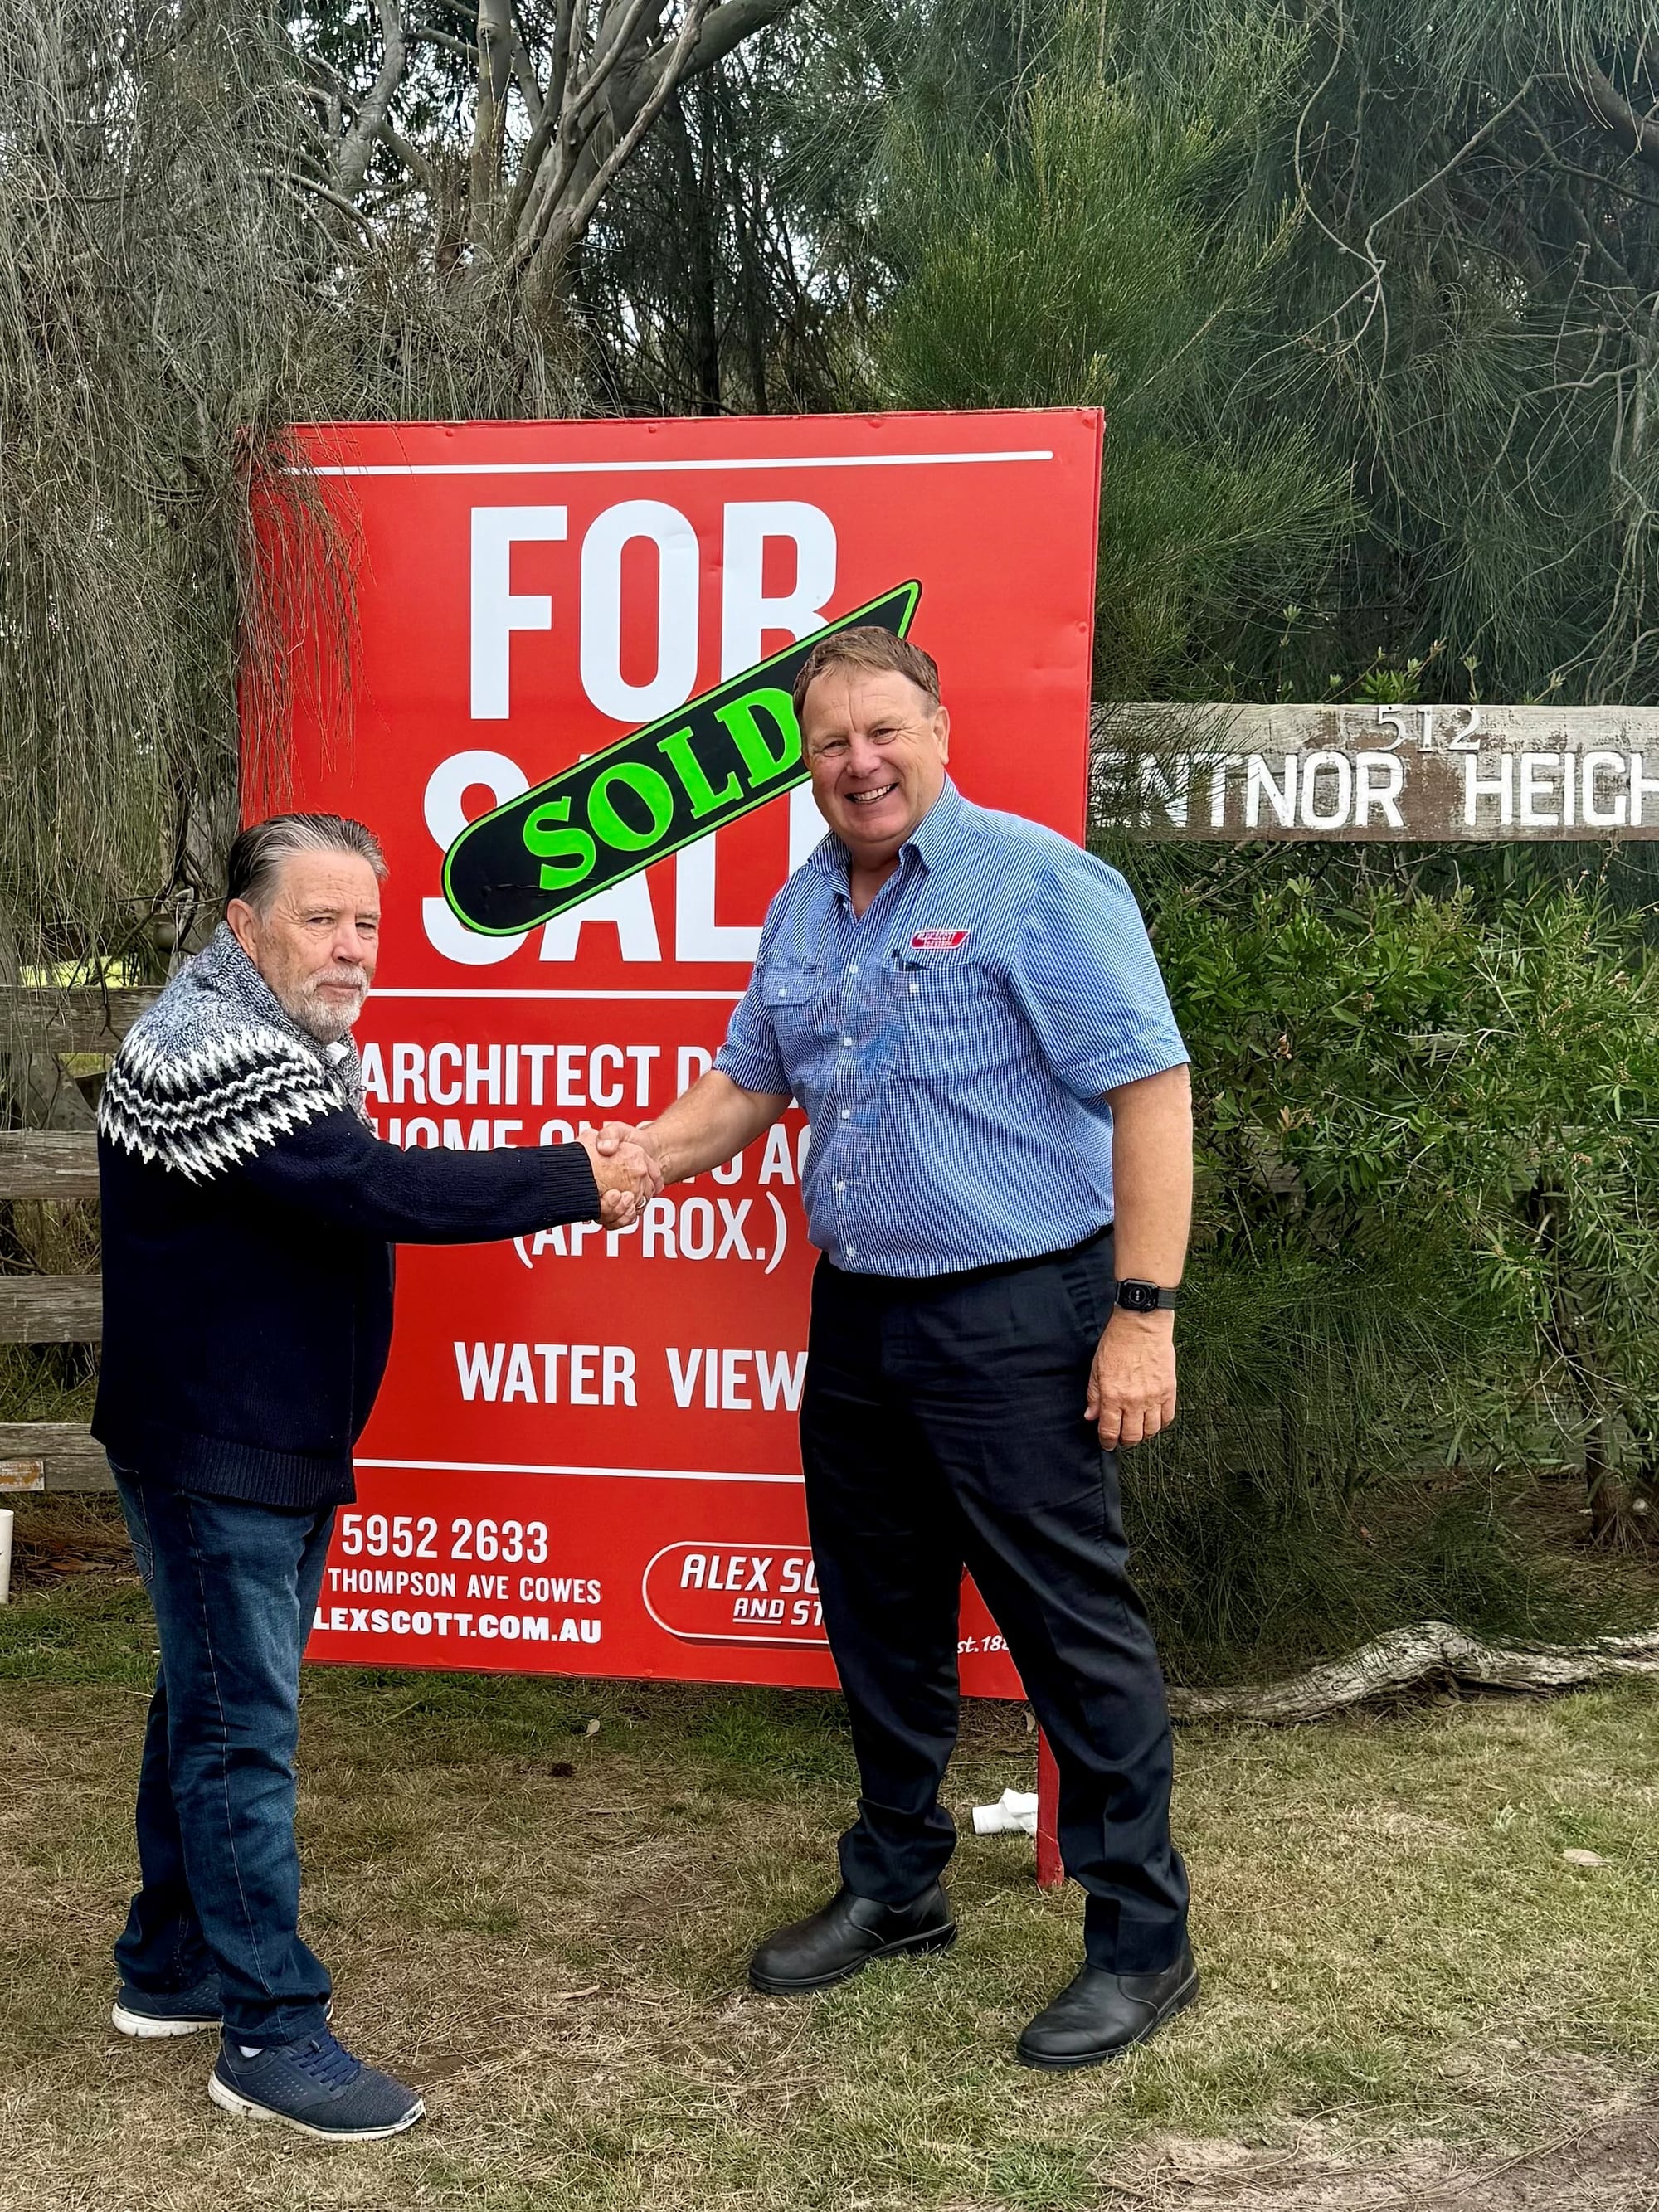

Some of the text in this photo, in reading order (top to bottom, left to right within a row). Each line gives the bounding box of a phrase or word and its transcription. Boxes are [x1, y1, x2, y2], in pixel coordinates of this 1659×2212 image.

[470, 499, 837, 723] FOR
[1377, 706, 1481, 751] 512
[523, 688, 802, 891] SOLD
[360, 1042, 661, 1108] ARCHITECT
[454, 1341, 638, 1407] WATER
[342, 1514, 548, 1563] 5952 2633
[328, 1568, 601, 1605] THOMPSON AVE COWES
[680, 1553, 773, 1592] ALEX
[733, 1597, 785, 1619] AND
